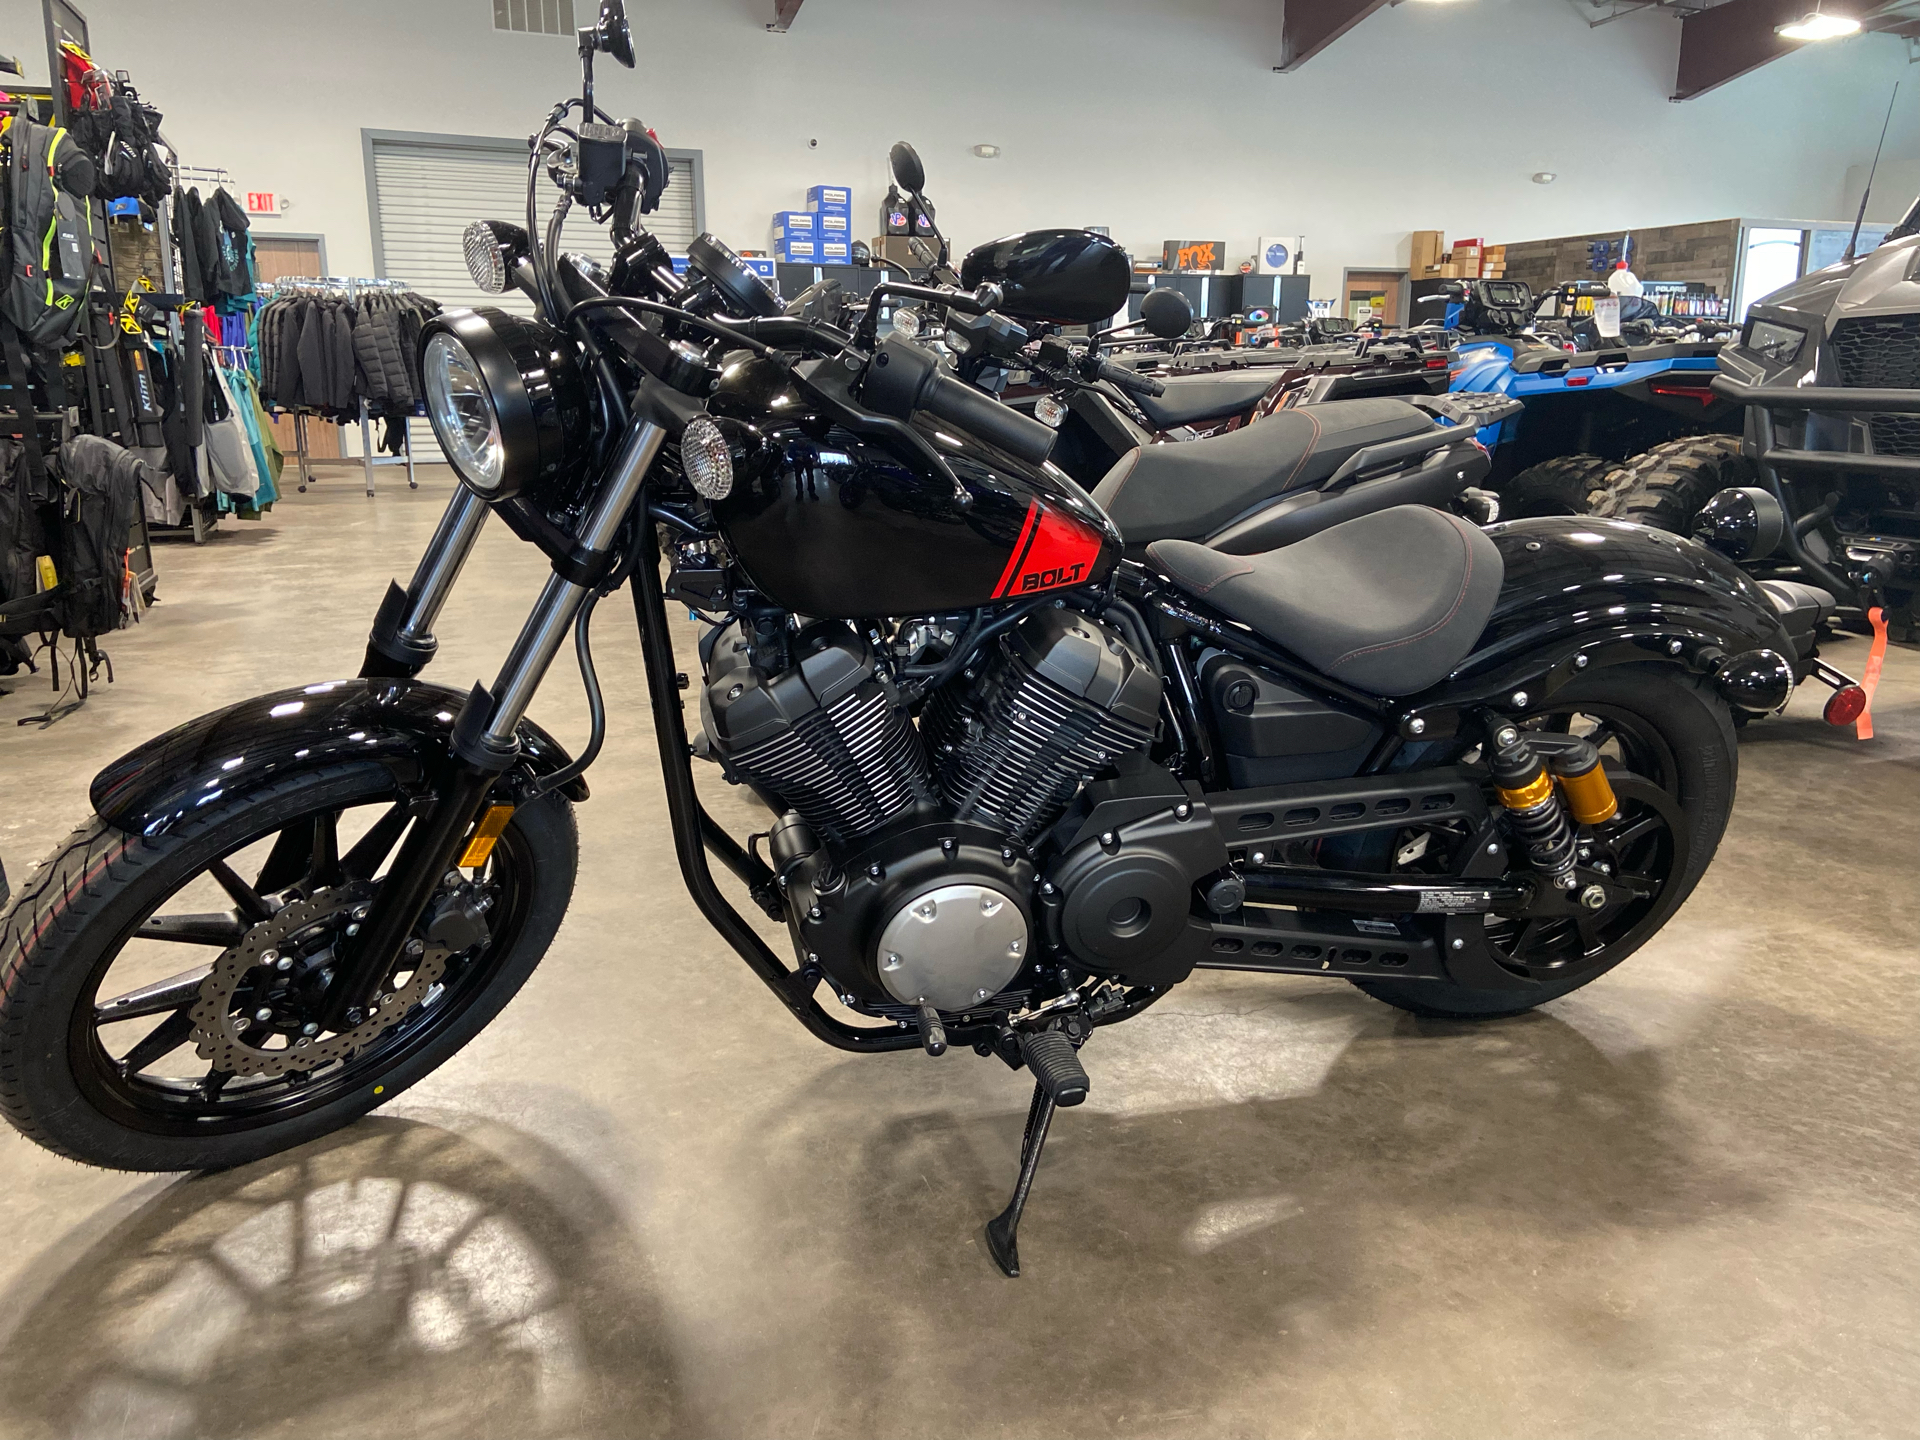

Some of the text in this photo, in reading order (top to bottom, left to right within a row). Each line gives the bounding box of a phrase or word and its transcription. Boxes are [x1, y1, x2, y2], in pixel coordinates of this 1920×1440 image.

[247, 192, 274, 212] EXIT
[1177, 242, 1216, 271] FOX
[1022, 563, 1085, 592] BOLT
